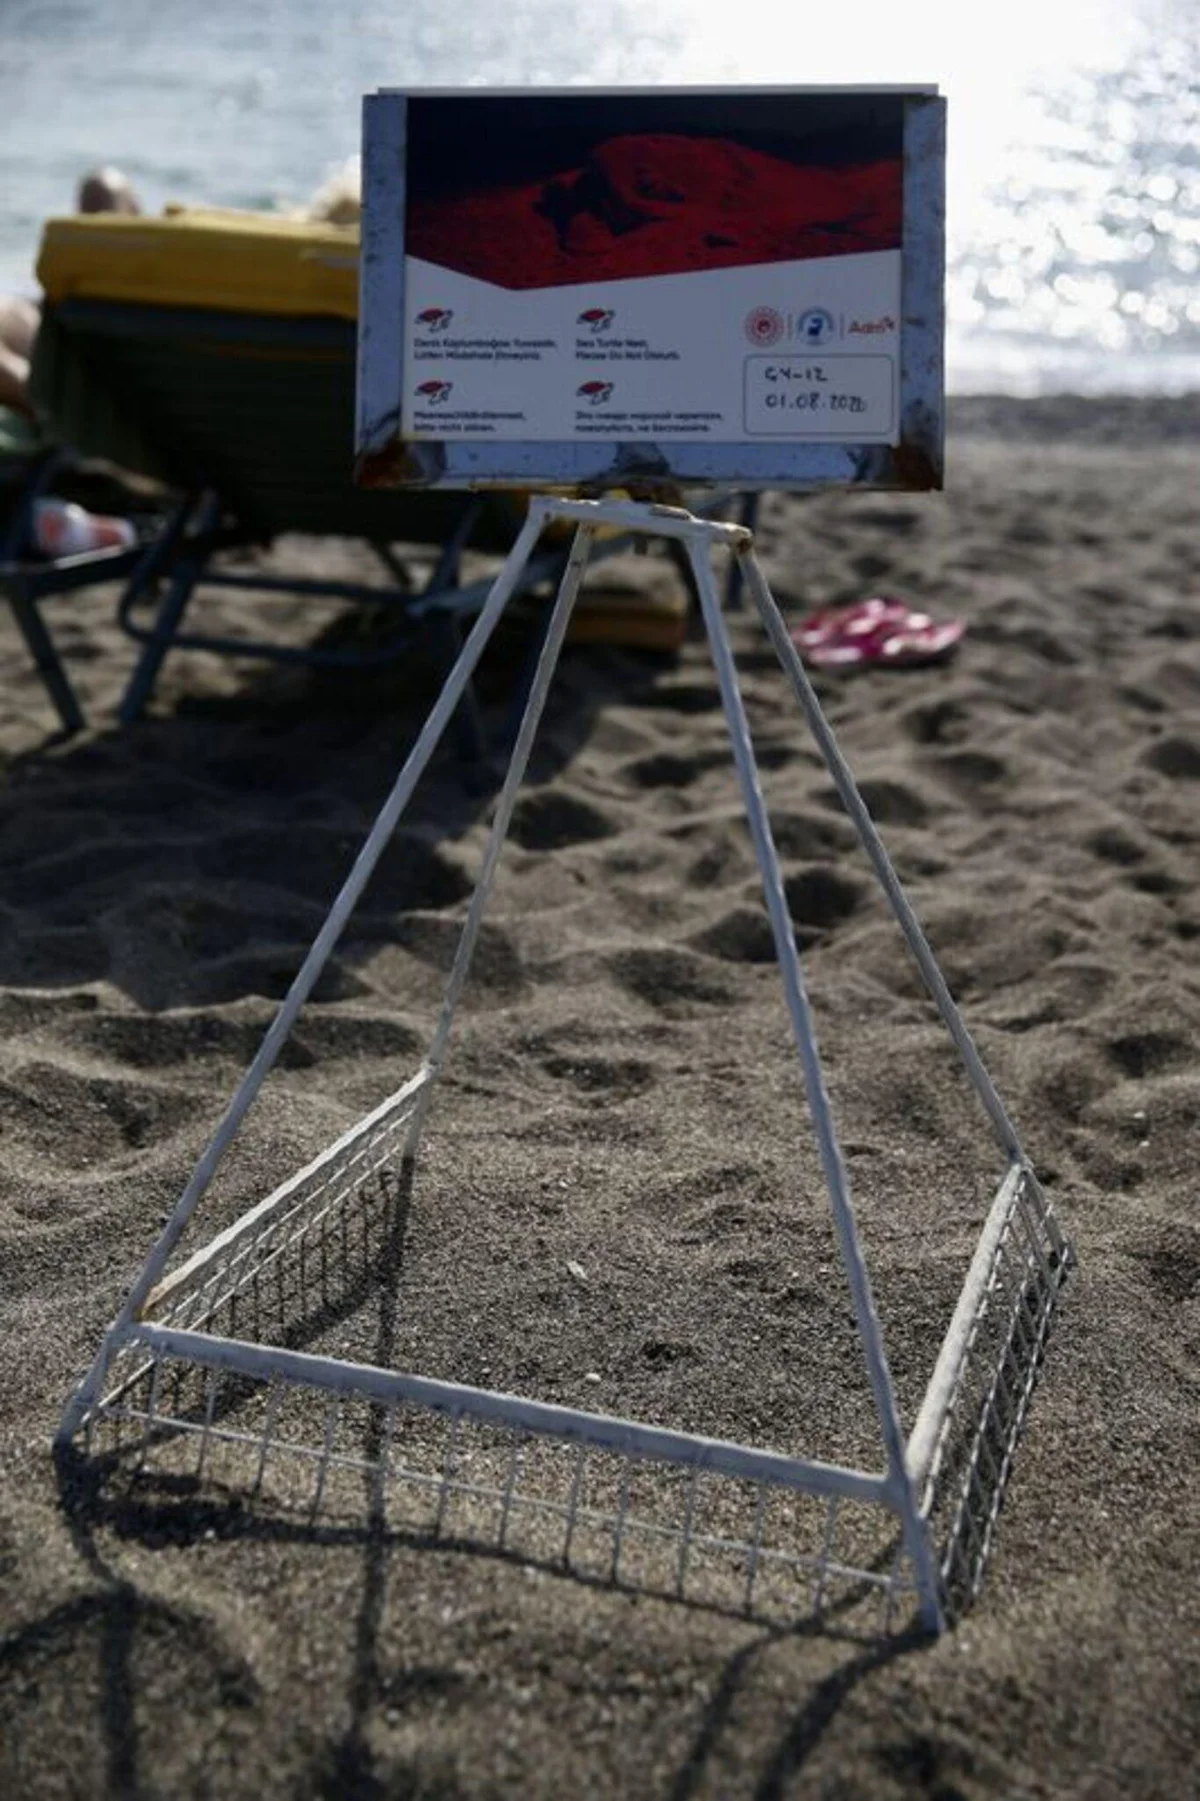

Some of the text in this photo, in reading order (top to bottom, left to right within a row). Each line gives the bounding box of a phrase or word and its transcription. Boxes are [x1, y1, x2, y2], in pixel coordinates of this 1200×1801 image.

[576, 338, 595, 348] Sea
[597, 337, 622, 348] Turtle
[609, 350, 623, 360] Do
[625, 350, 642, 360] Not
